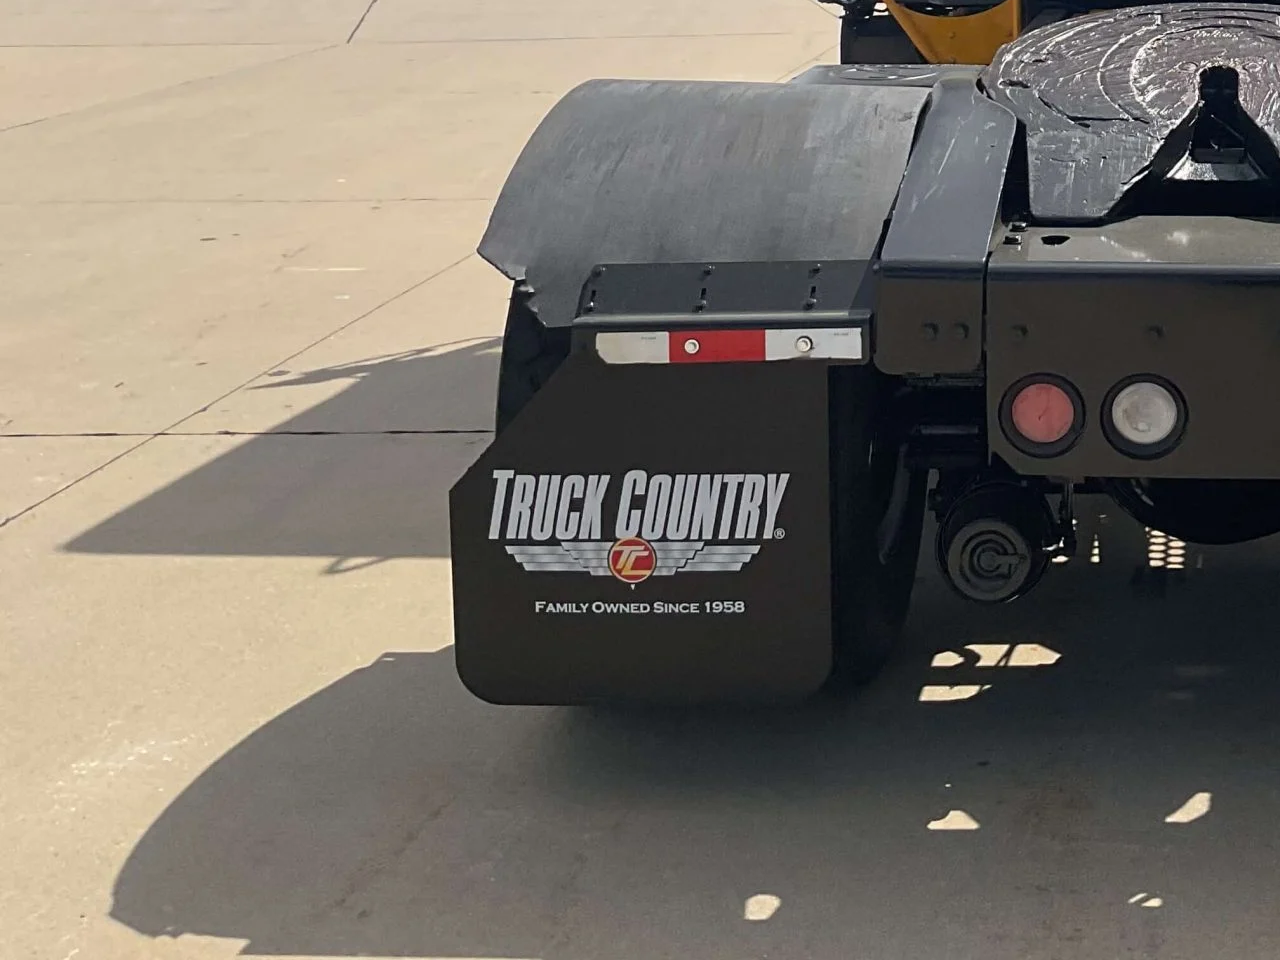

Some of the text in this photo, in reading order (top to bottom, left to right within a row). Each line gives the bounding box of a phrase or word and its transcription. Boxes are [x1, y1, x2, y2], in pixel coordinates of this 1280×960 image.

[489, 470, 610, 540] TRUCK
[535, 601, 745, 614] FAMILY OWNED SINCE 1958
